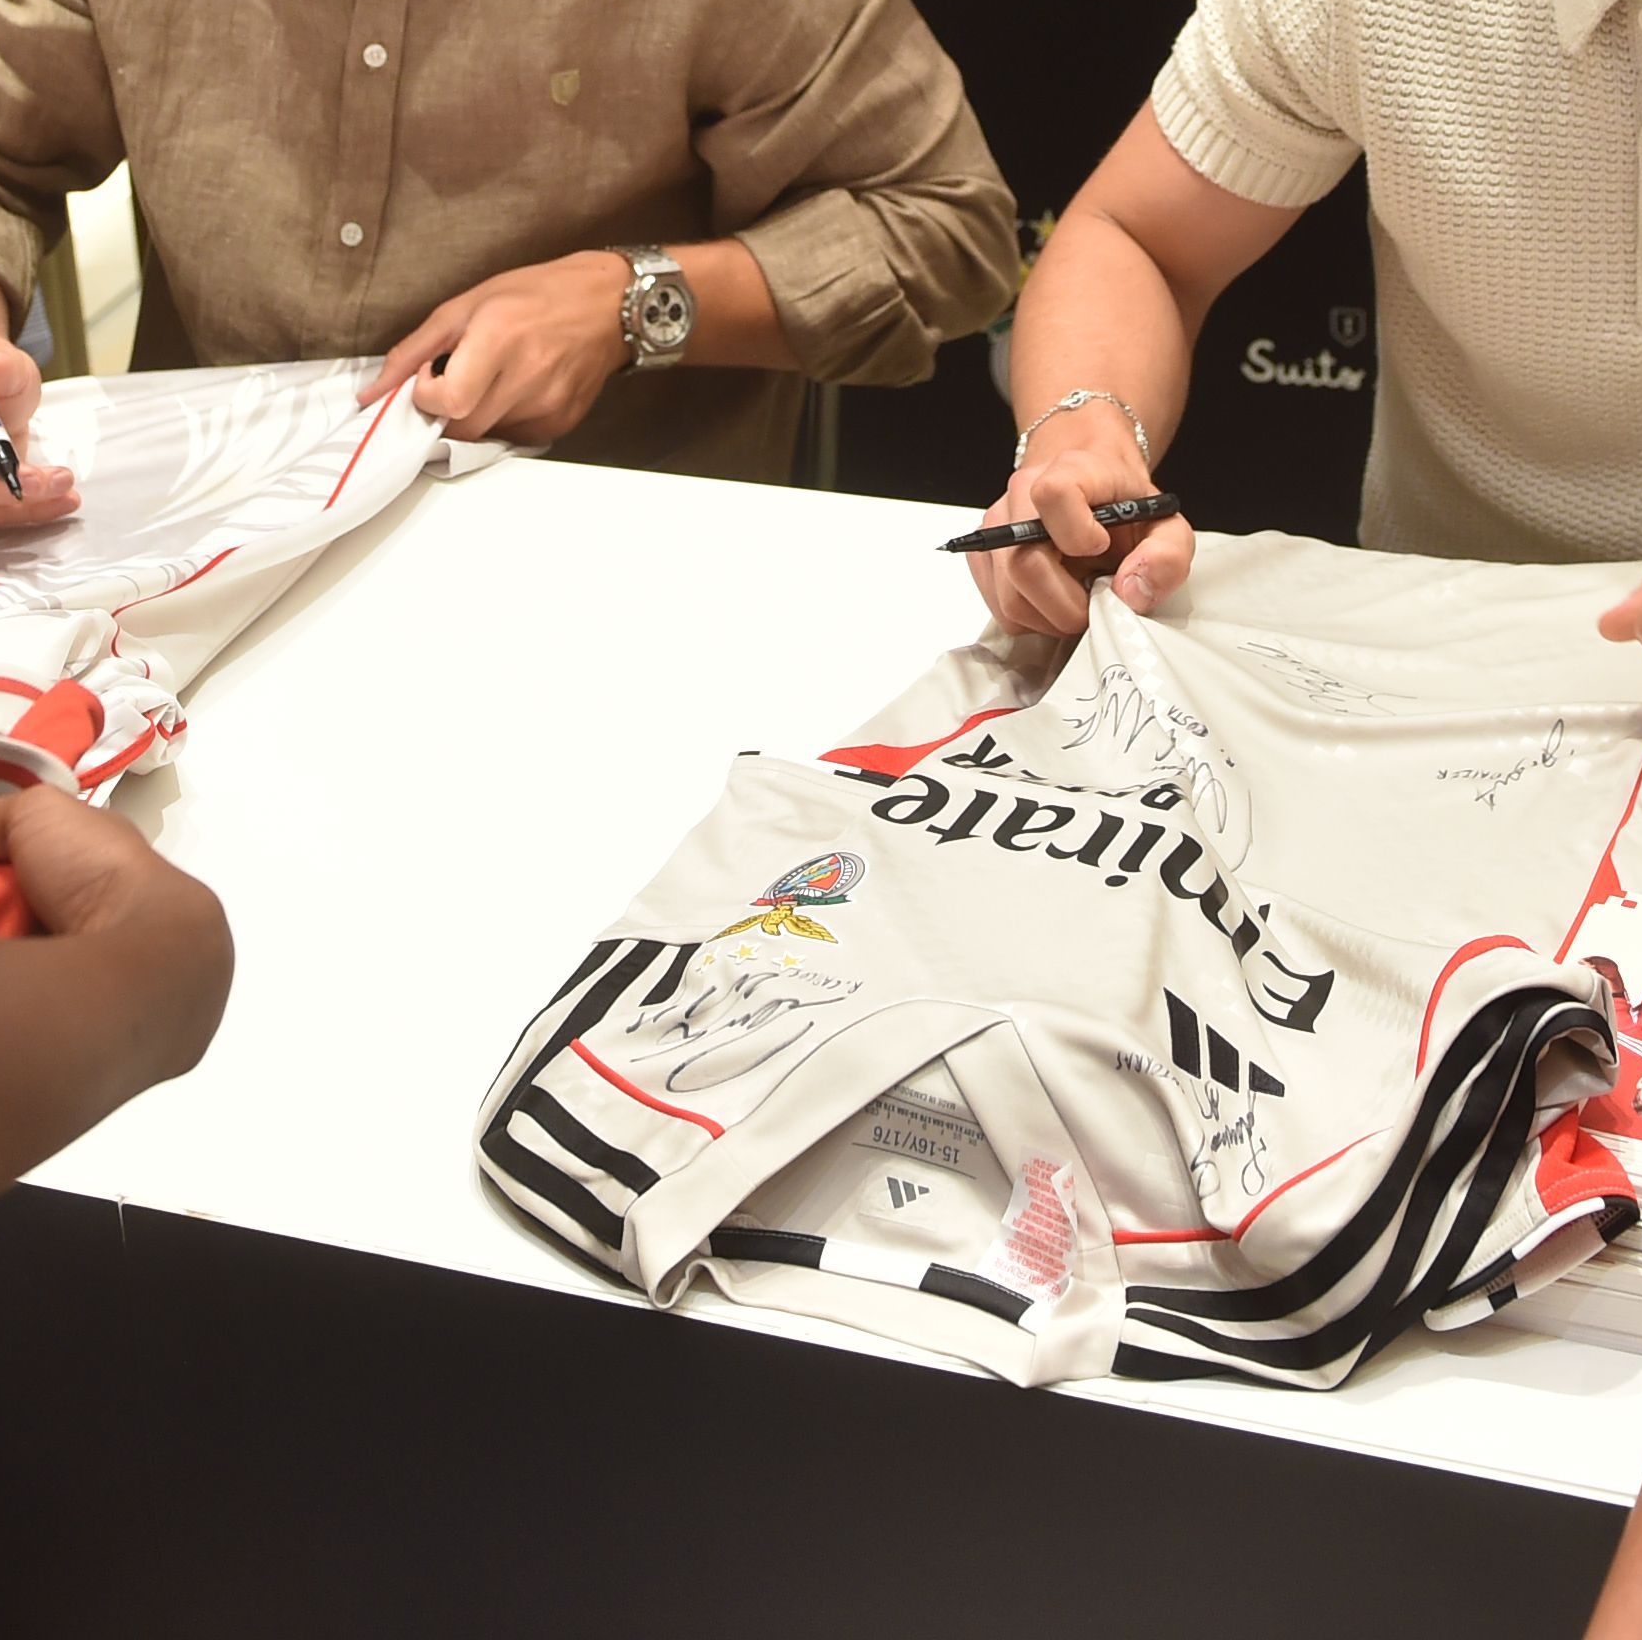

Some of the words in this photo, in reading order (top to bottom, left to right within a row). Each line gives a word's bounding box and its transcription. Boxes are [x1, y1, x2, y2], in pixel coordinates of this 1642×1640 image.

[1240, 338, 1366, 391] Suits
[870, 772, 1336, 1036] Emirate
[872, 1125, 960, 1164] 15-16Y/176
